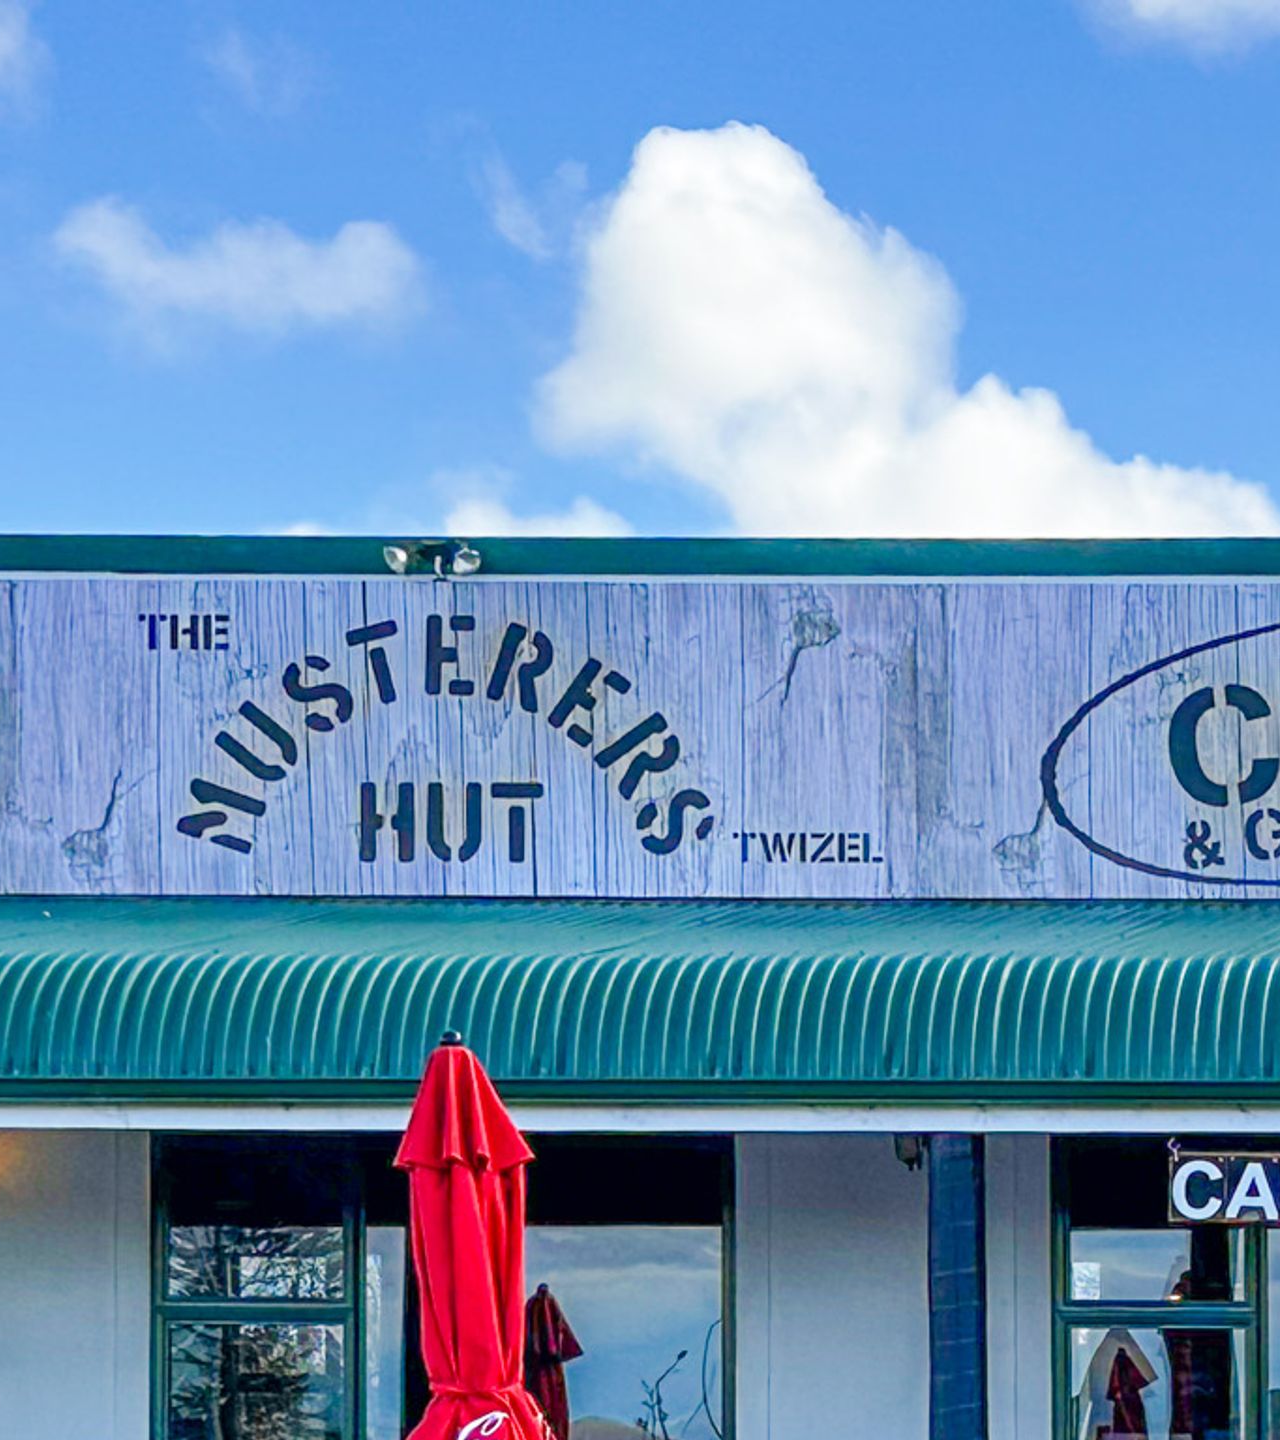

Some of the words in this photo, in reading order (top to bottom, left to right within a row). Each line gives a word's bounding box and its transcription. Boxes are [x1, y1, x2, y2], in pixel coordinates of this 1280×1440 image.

[138, 614, 229, 650] THE
[177, 614, 715, 856] MUSTERERS
[360, 782, 544, 862] HUT
[1184, 819, 1225, 869] &
[733, 833, 883, 863] TWIZEL
